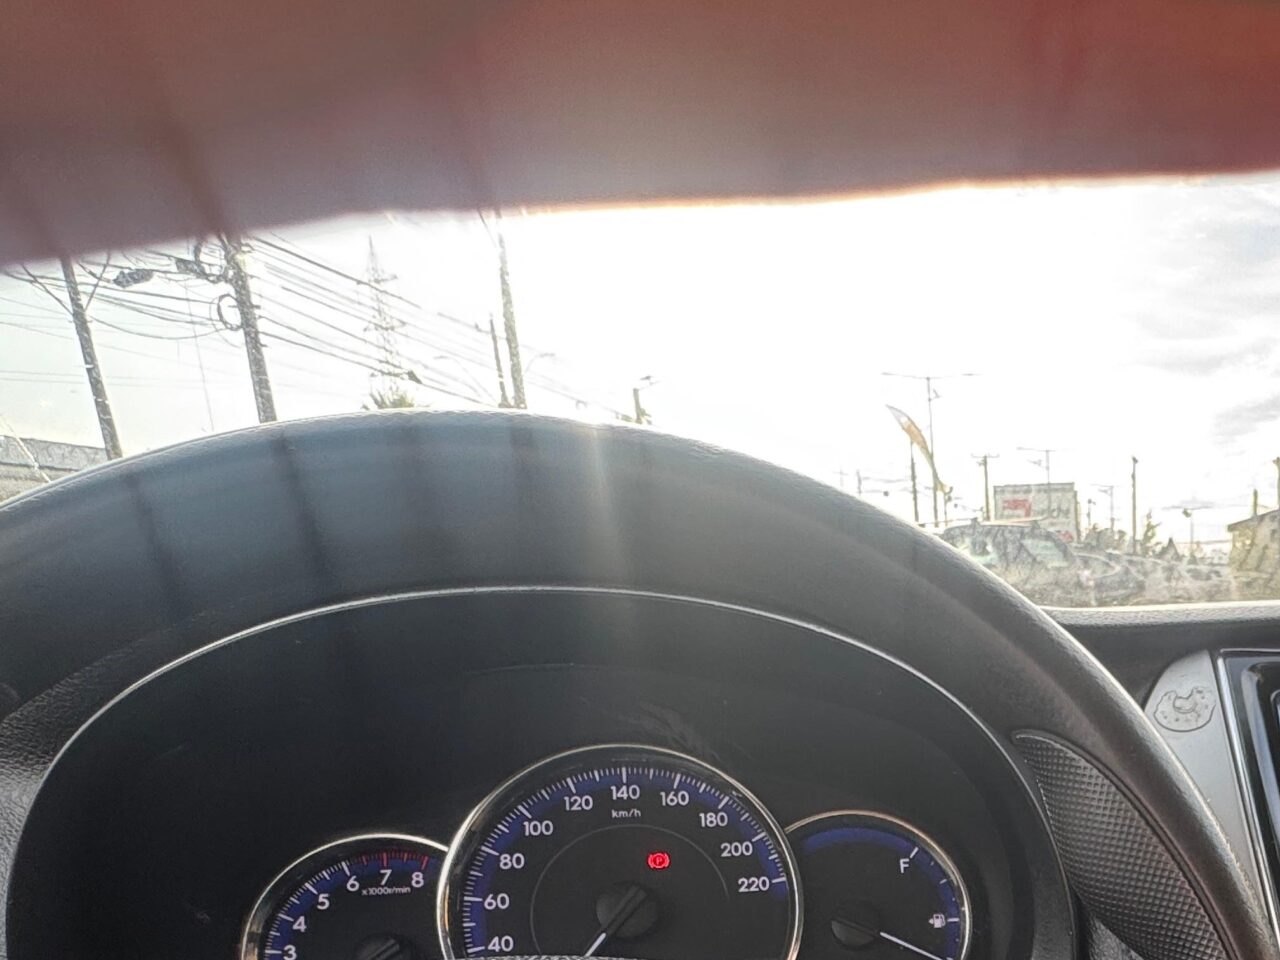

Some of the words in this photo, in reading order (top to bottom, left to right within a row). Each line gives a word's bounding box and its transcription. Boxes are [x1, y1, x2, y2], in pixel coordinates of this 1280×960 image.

[610, 784, 640, 800] 140
[660, 791, 689, 806] 160
[564, 795, 593, 811] 120
[612, 808, 641, 818] km/h
[699, 812, 728, 827] 180
[523, 820, 553, 836] 100
[720, 841, 753, 857] 200
[500, 853, 525, 869] 80
[900, 858, 910, 873] F
[346, 875, 360, 891] 6
[380, 869, 392, 886] 7
[411, 871, 424, 888] 8
[738, 876, 770, 893] 220
[317, 893, 330, 910] 5
[484, 892, 510, 910] 60
[292, 916, 307, 933] 4
[487, 935, 514, 952] 40
